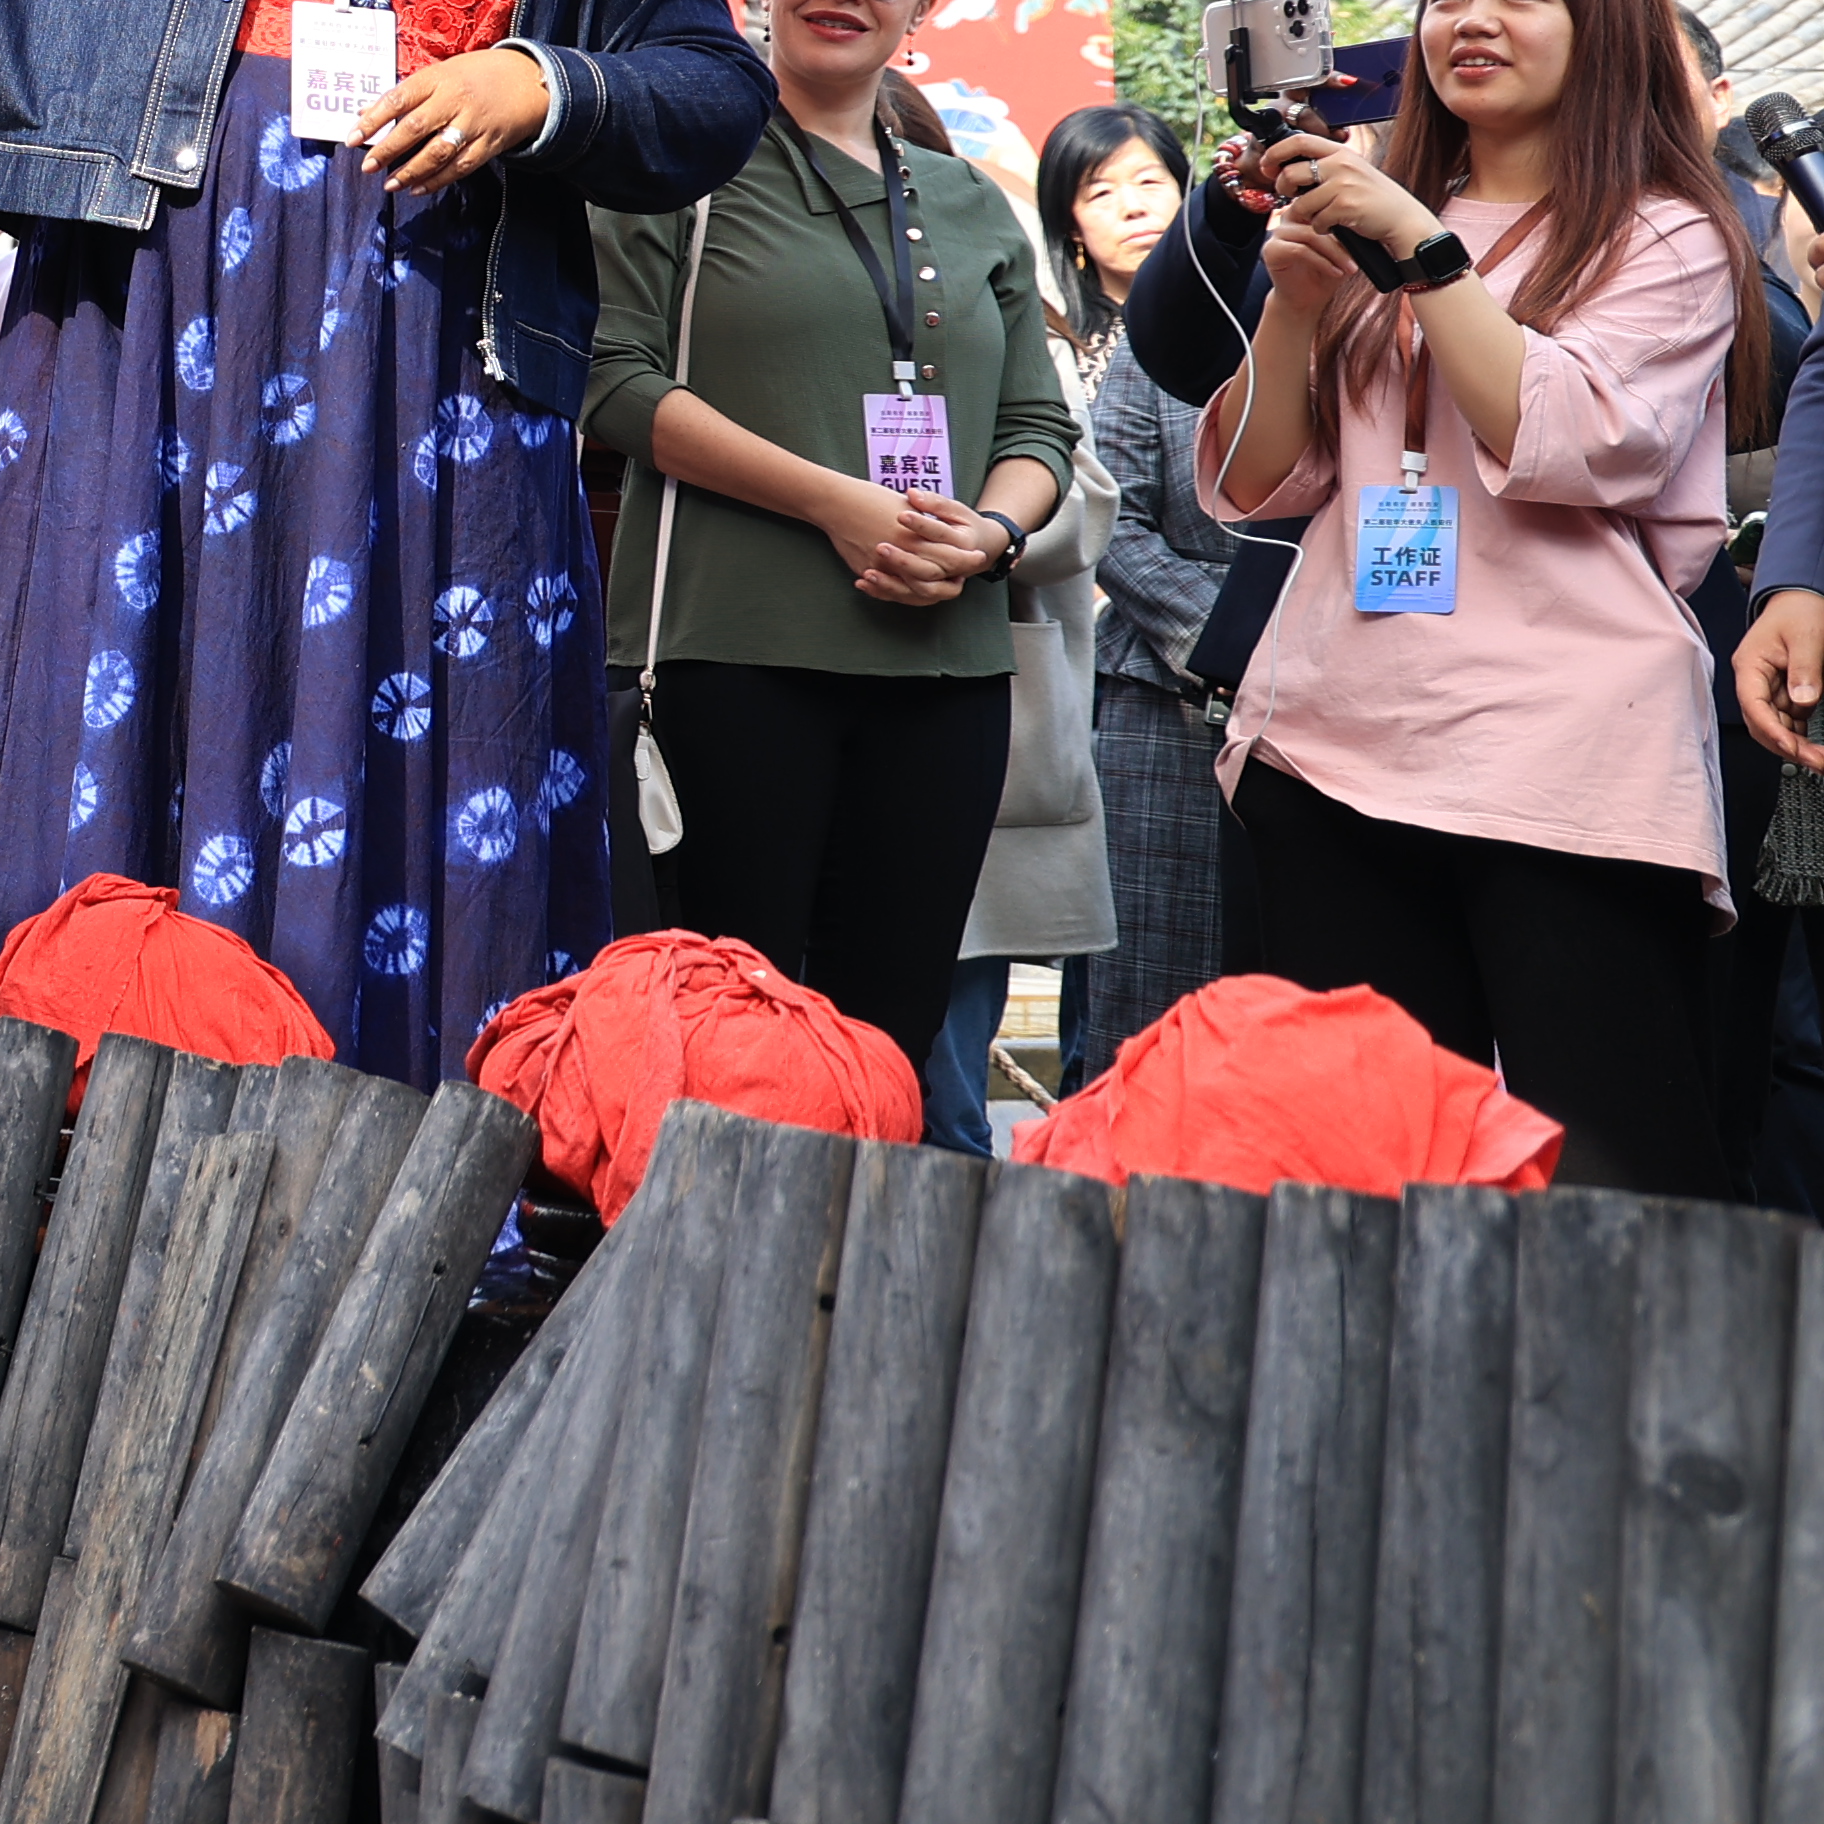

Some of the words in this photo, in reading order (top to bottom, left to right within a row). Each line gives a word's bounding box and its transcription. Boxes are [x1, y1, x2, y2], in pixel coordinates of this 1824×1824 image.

[307, 69, 382, 95] 嘉宾证
[306, 93, 375, 115] GUES
[879, 455, 941, 475] 嘉宾证
[1371, 546, 1442, 567] 工作证
[1370, 570, 1442, 587] STAFF
